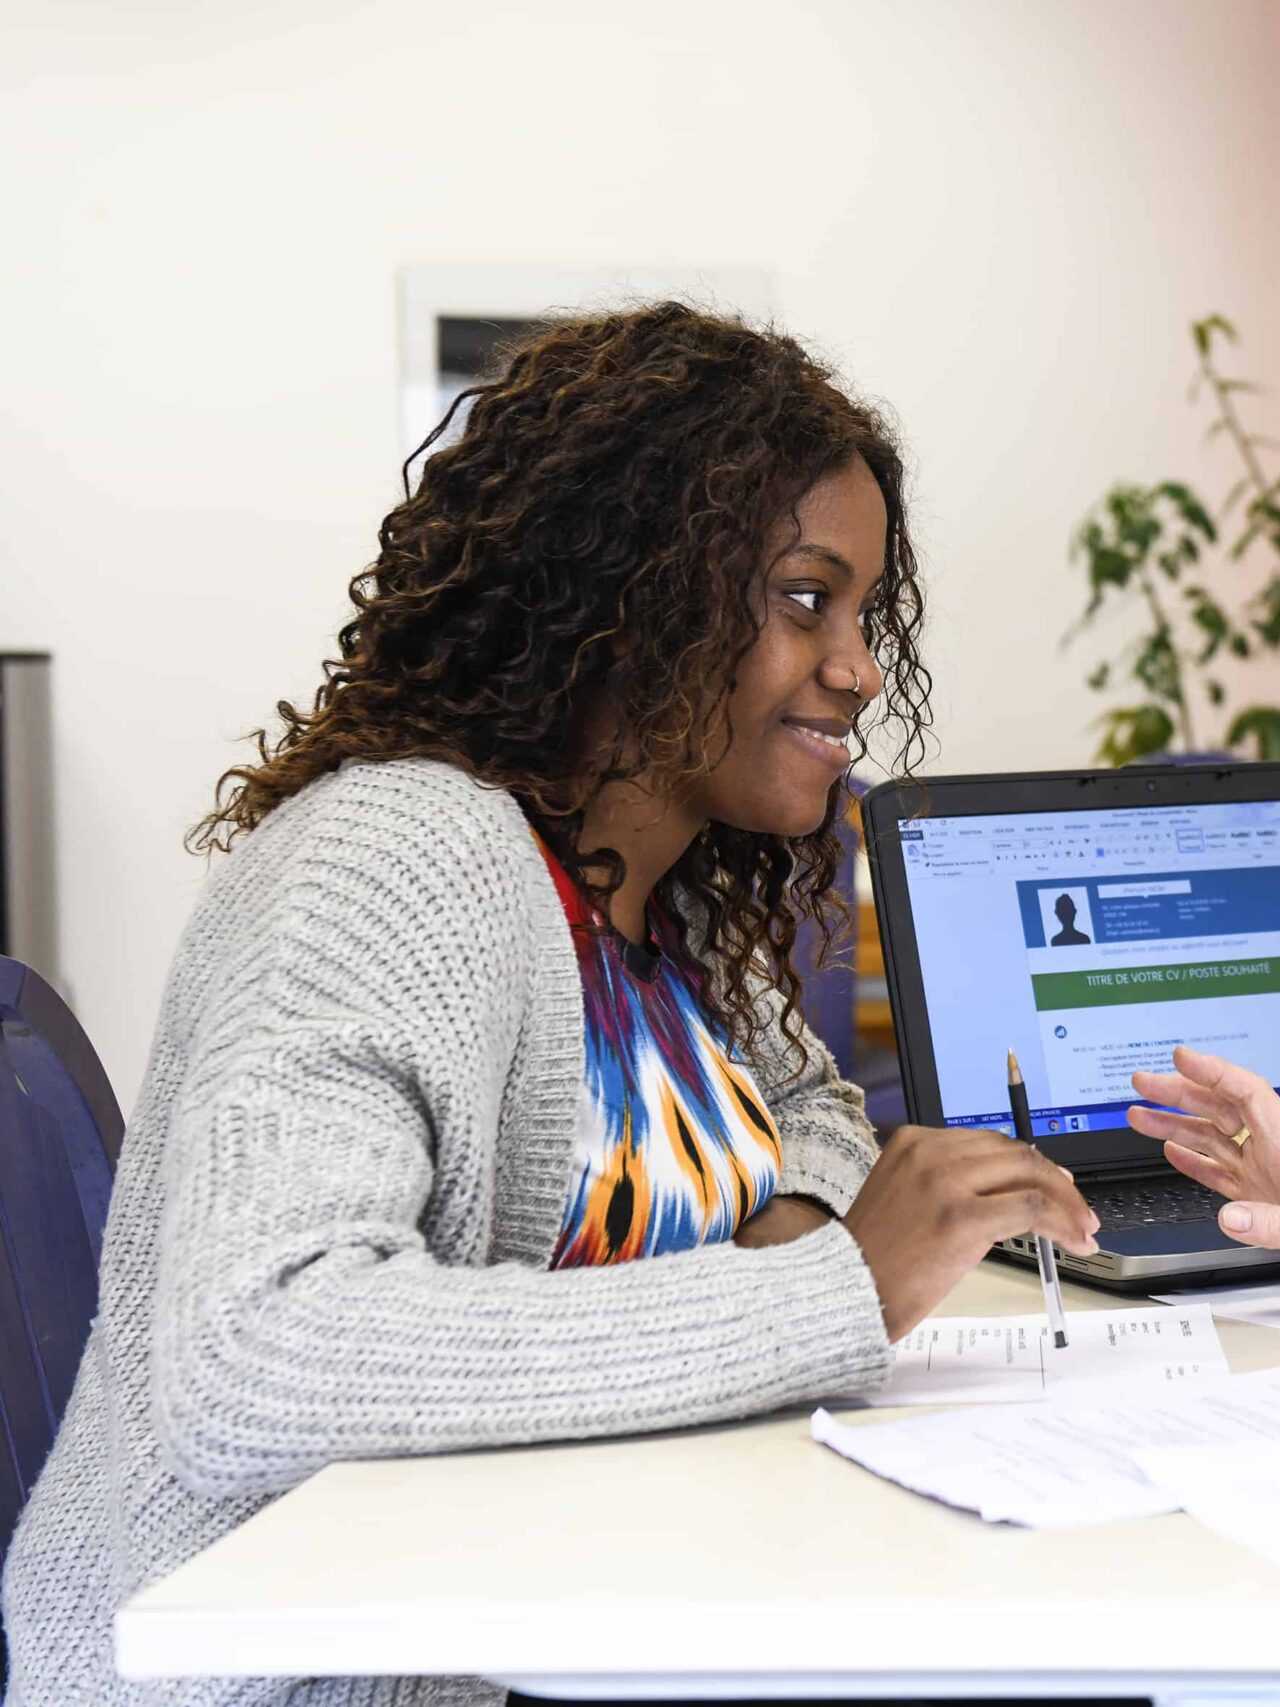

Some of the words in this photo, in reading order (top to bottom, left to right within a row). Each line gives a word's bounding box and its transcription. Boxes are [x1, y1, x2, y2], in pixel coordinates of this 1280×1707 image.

[1086, 975, 1113, 986] TITRE
[1116, 973, 1129, 985] DE
[1131, 971, 1163, 983] VOTRE
[1166, 969, 1180, 981] CV
[1189, 966, 1220, 979] POSTE
[1223, 960, 1271, 977] SOUHAITÉ
